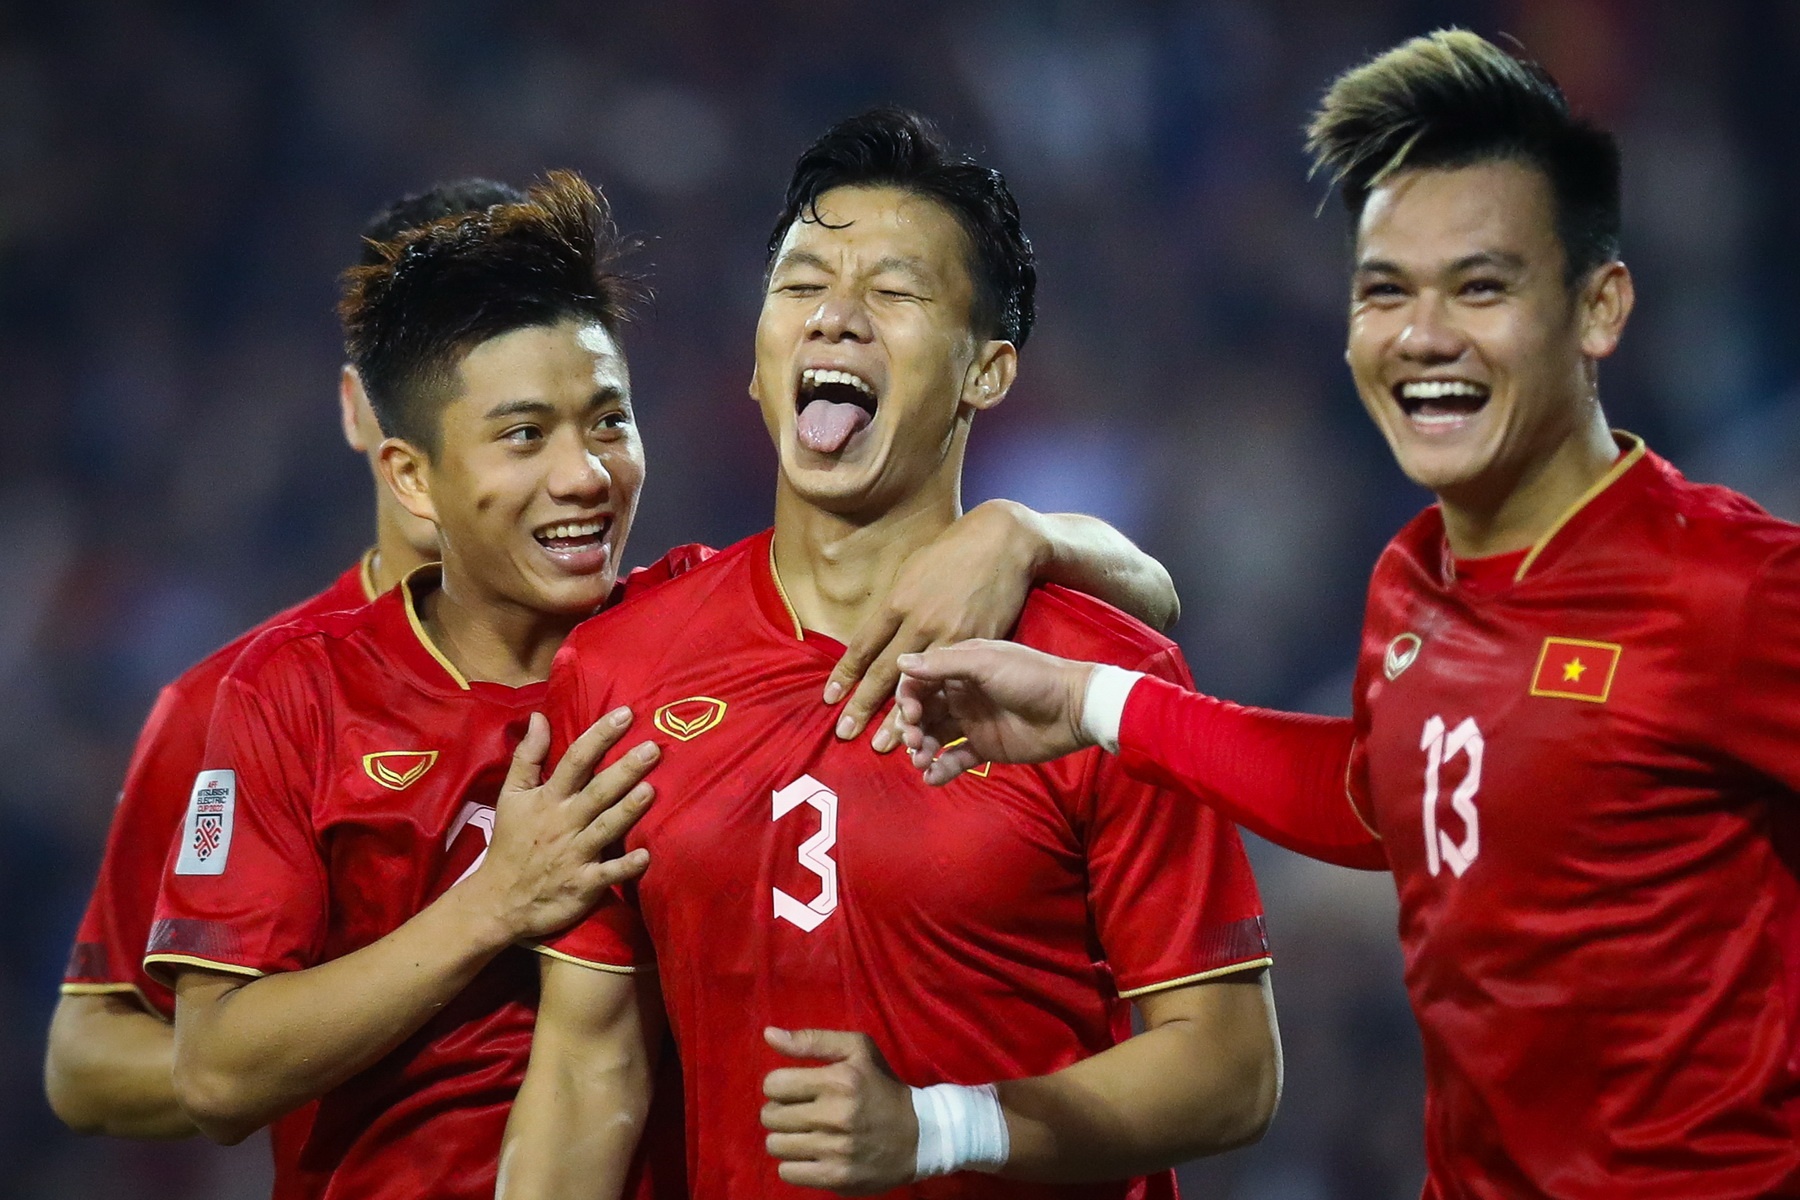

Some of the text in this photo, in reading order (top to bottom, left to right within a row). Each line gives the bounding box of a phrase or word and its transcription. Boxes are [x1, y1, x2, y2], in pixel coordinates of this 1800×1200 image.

[197, 796, 227, 804] ELECTRIC
[771, 773, 839, 933] 3
[1420, 714, 1485, 879] 13
